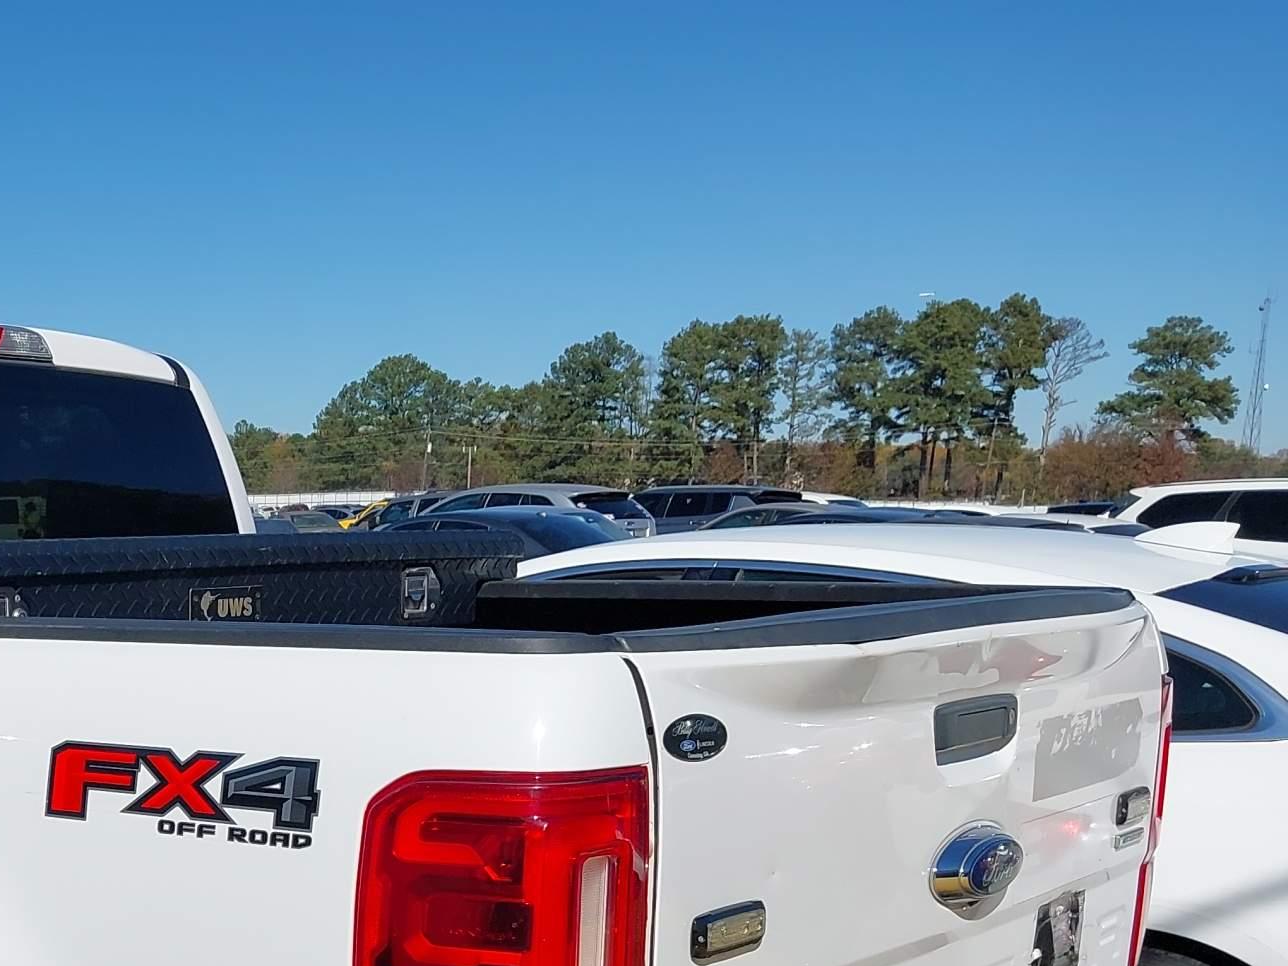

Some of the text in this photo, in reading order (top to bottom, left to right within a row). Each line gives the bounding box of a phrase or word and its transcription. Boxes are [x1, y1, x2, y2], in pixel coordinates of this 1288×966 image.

[217, 597, 253, 618] UWS
[44, 739, 321, 832] FX4
[157, 819, 313, 849] OFF ROAD
